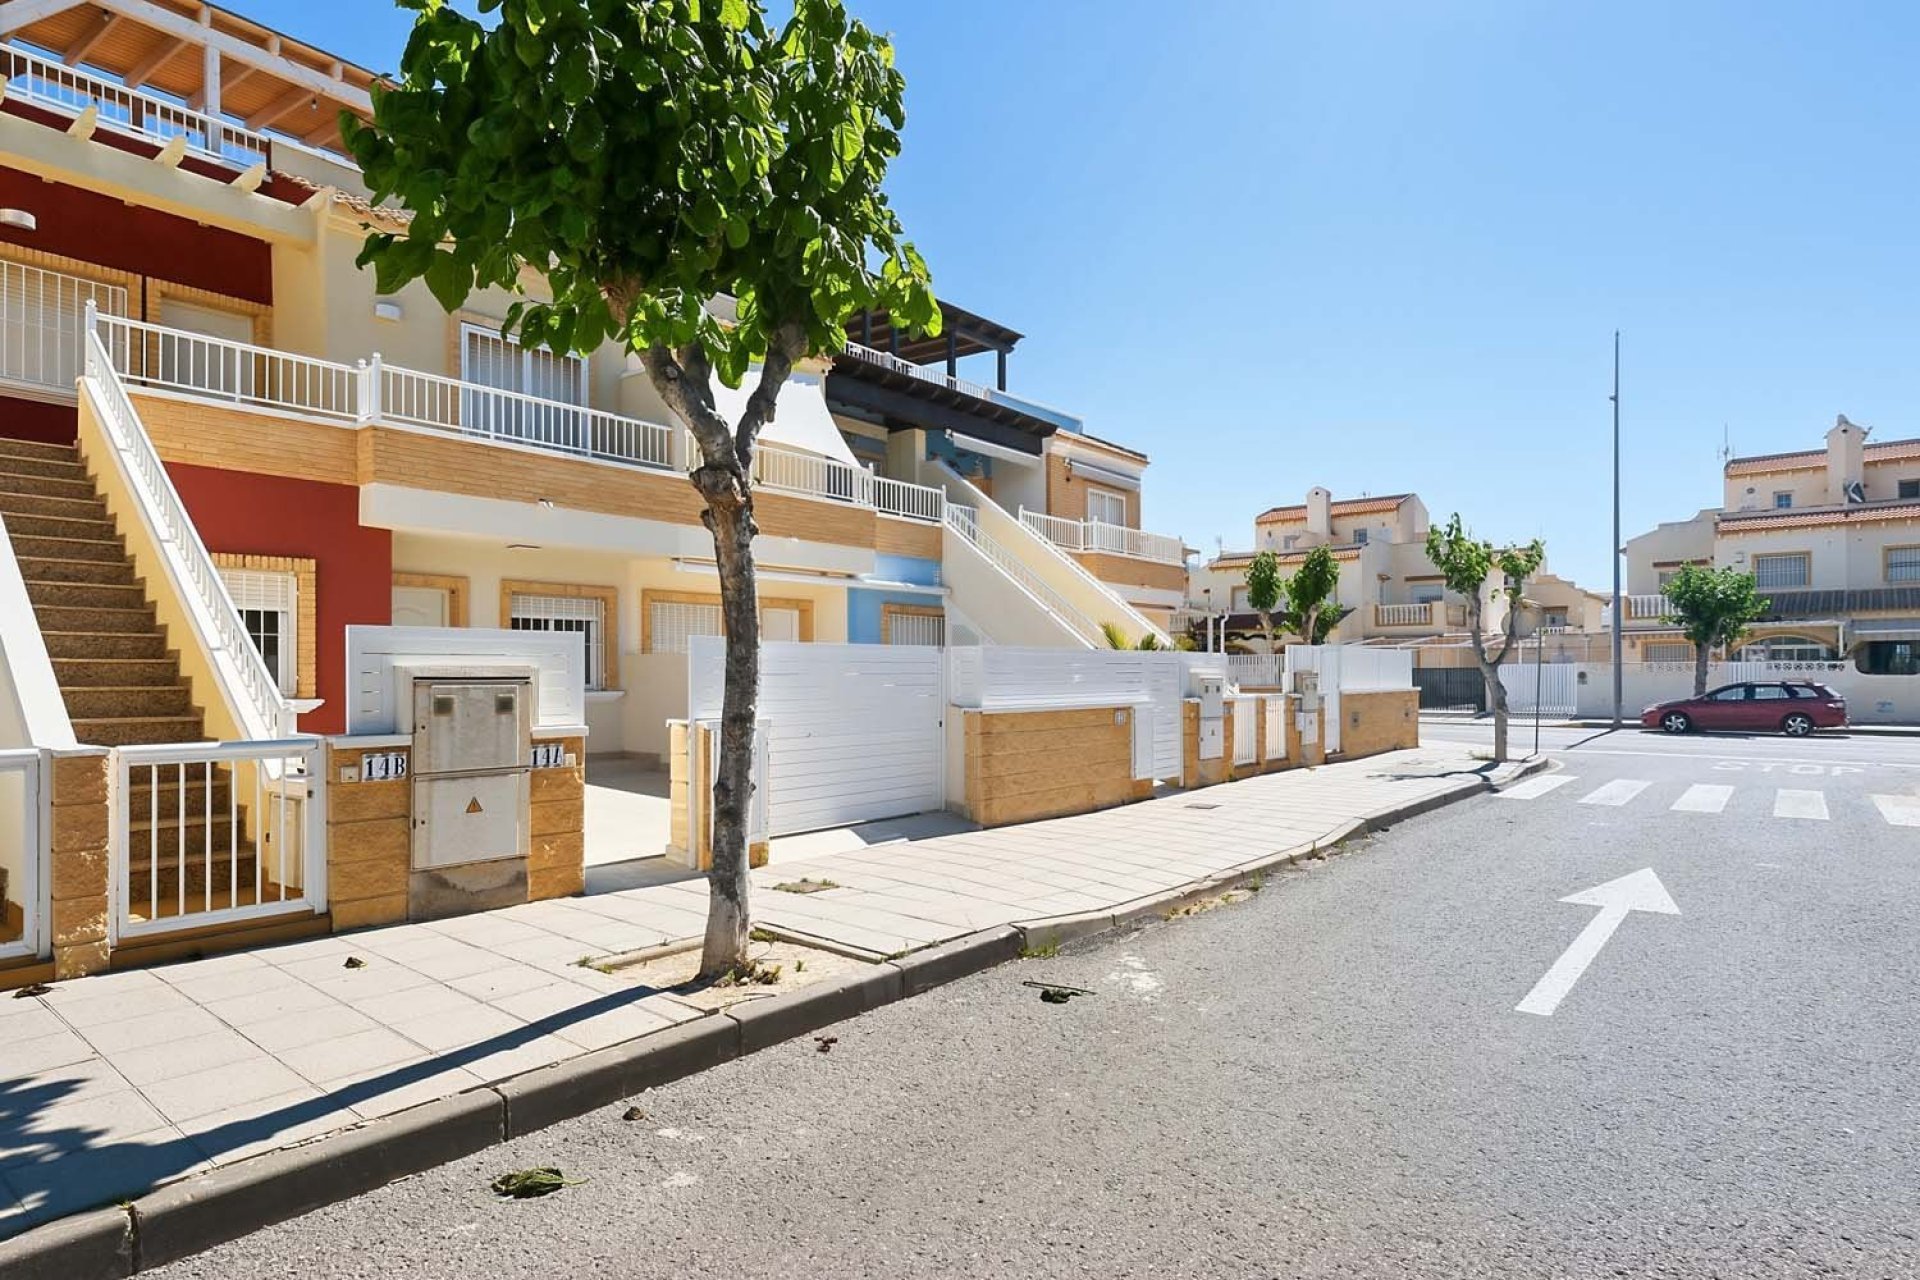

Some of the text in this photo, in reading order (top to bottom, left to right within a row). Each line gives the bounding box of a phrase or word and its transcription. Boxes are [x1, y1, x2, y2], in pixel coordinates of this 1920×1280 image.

[533, 746, 563, 765] 14A
[366, 757, 406, 777] 14B
[1711, 761, 1865, 777] STOP
